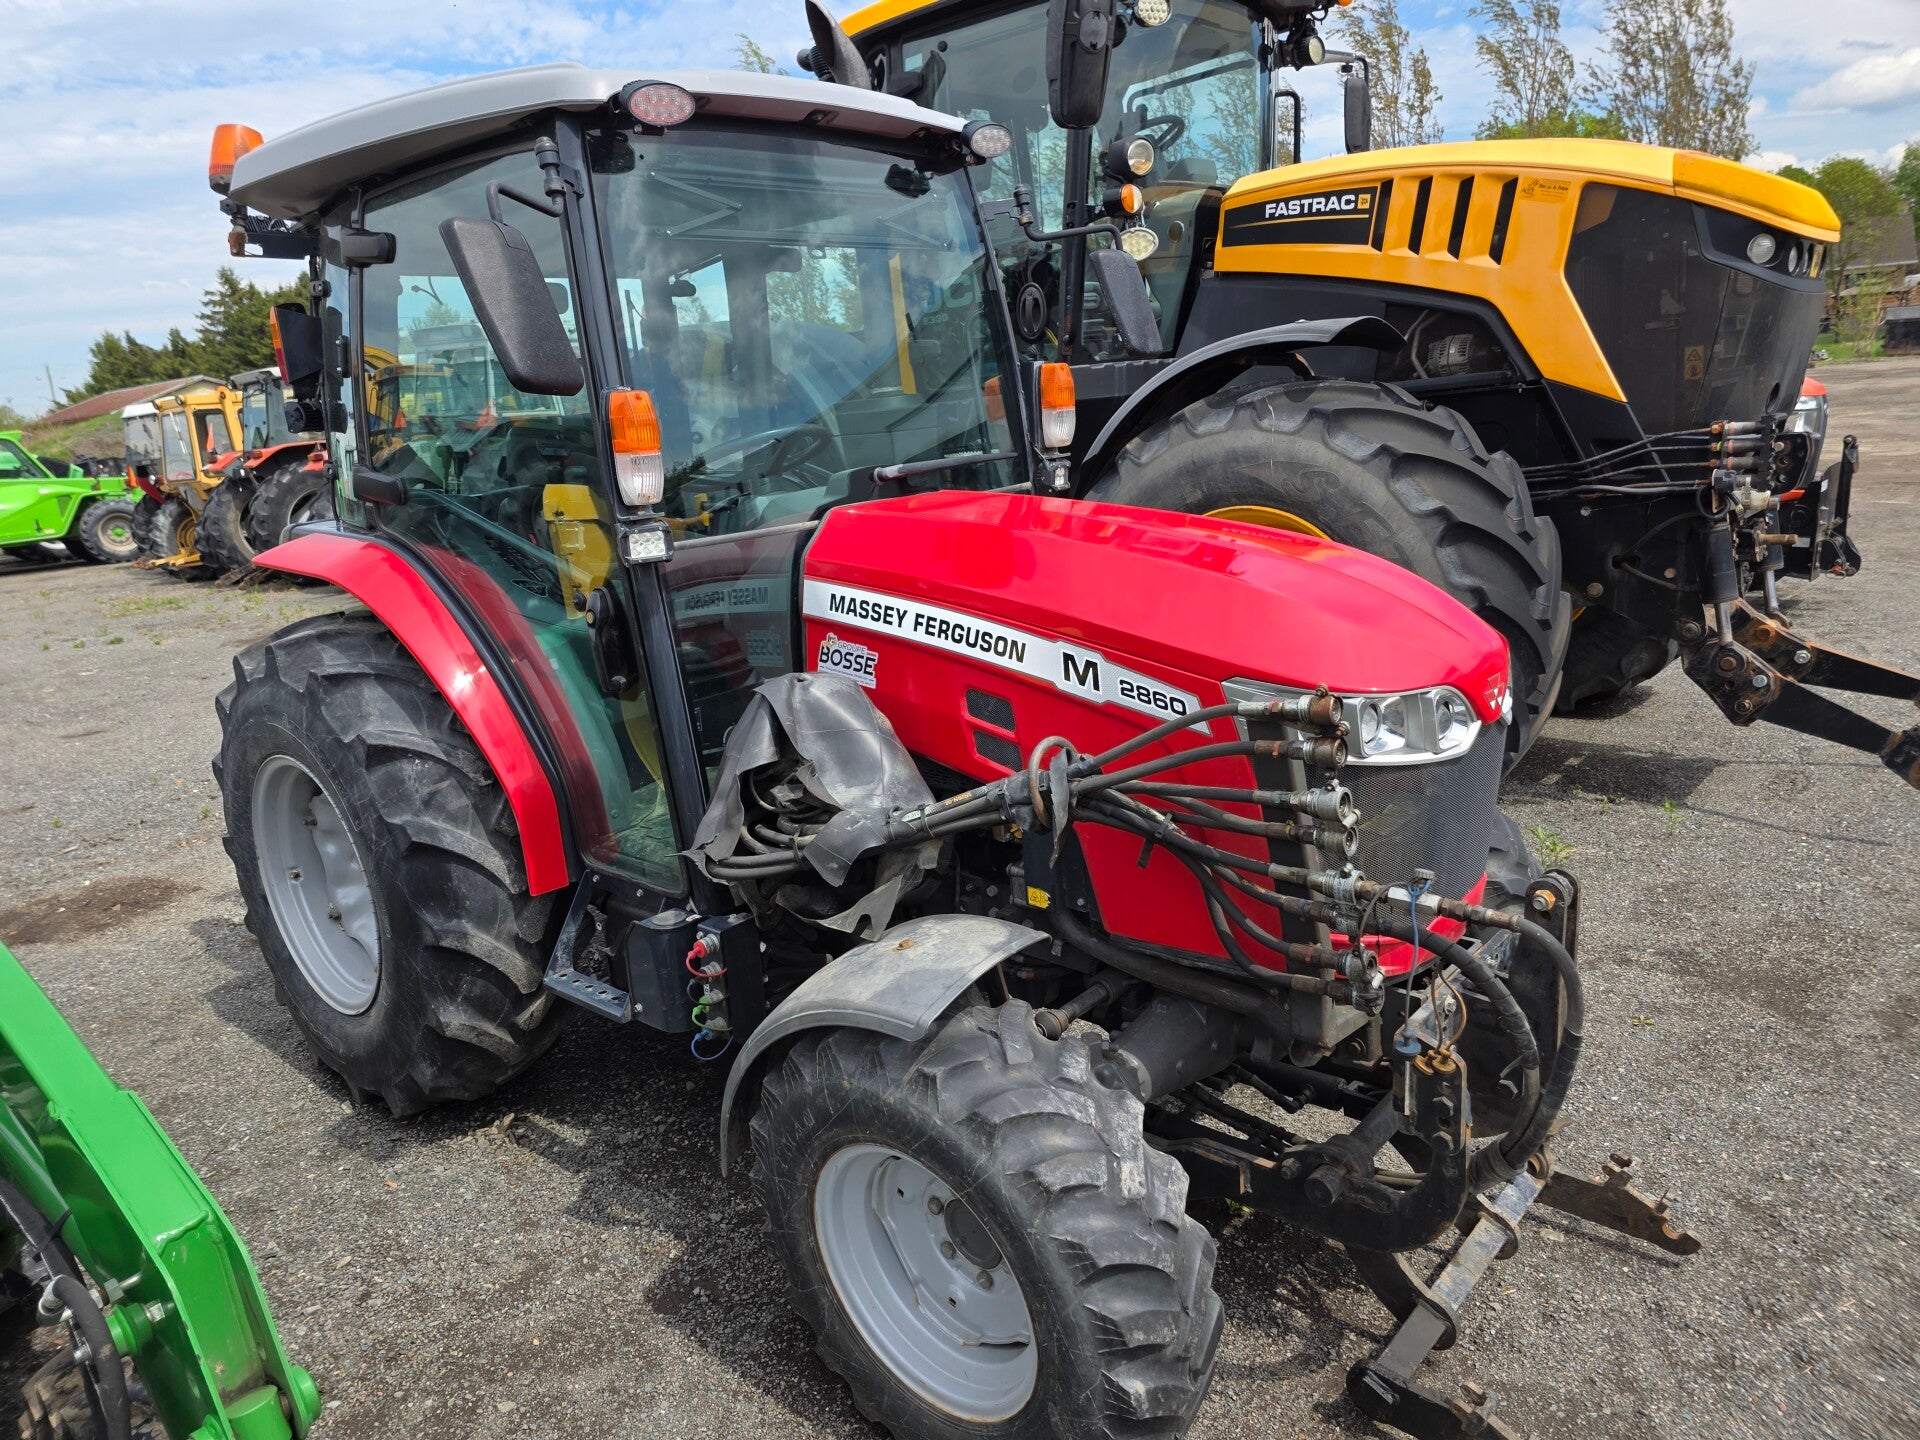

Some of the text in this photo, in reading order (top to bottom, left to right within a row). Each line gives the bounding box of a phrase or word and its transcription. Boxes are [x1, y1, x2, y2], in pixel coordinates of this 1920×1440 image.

[1265, 194, 1356, 218] FASTRAC
[829, 593, 1027, 663] MASSEY FERGUSON
[819, 645, 876, 676] BOSSE
[837, 641, 867, 655] GROUPE
[1062, 651, 1100, 692] M
[1119, 679, 1187, 717] 2860
